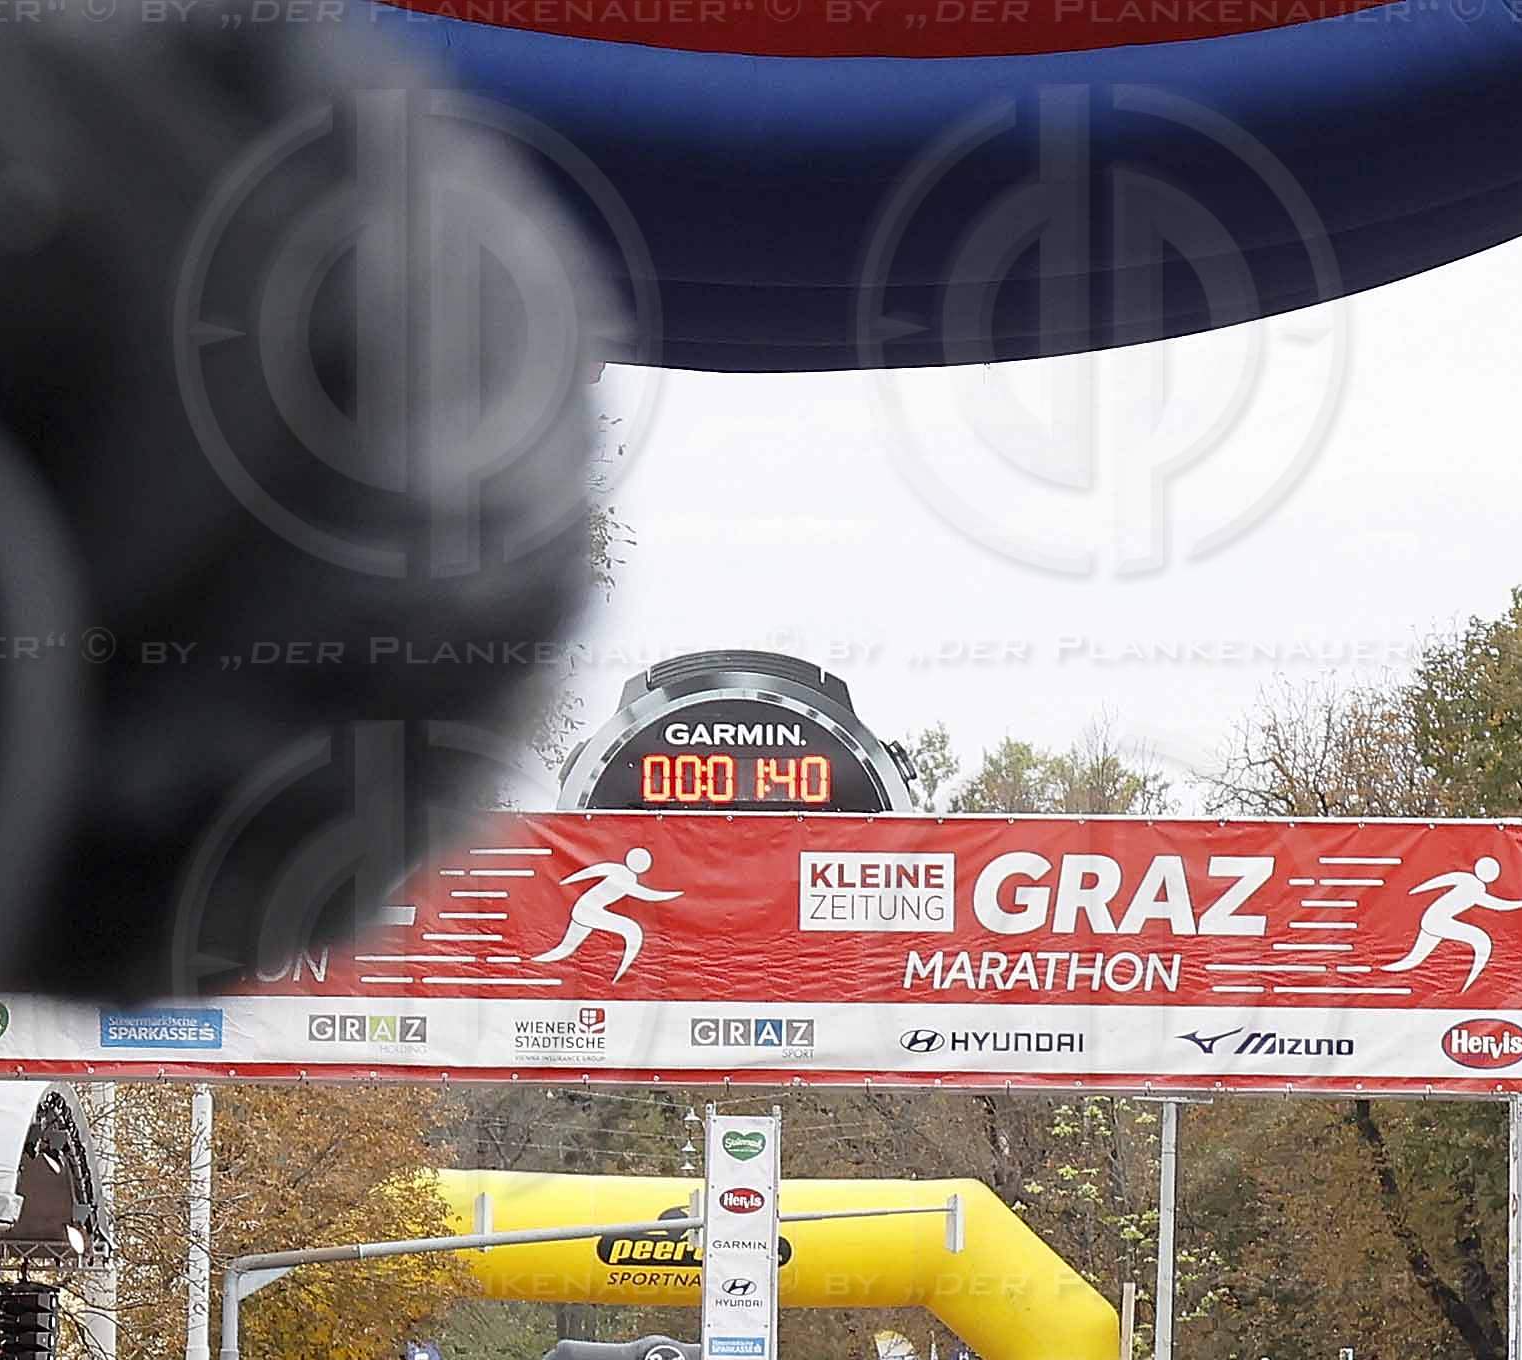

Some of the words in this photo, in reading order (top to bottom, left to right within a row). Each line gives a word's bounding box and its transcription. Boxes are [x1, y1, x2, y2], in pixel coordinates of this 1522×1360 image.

[809, 862, 945, 890] KLEINE
[972, 851, 1276, 936] GRAZ
[809, 894, 946, 922] ZEITUNG
[903, 951, 1182, 992] MARATHON
[108, 1026, 198, 1041] SPARKASSE
[310, 1016, 425, 1042] GRAZ
[515, 1021, 576, 1034] WIENER
[693, 1019, 813, 1046] GRAZ
[515, 1035, 606, 1049] STÄDTISCHE
[950, 1032, 1084, 1054] HYUNDAI
[782, 1049, 815, 1059] SPORT
[722, 1191, 763, 1208] Hervis
[608, 1238, 704, 1264] peer
[607, 1272, 703, 1287] SPORTNA
[715, 1299, 763, 1308] HYUNDAI
